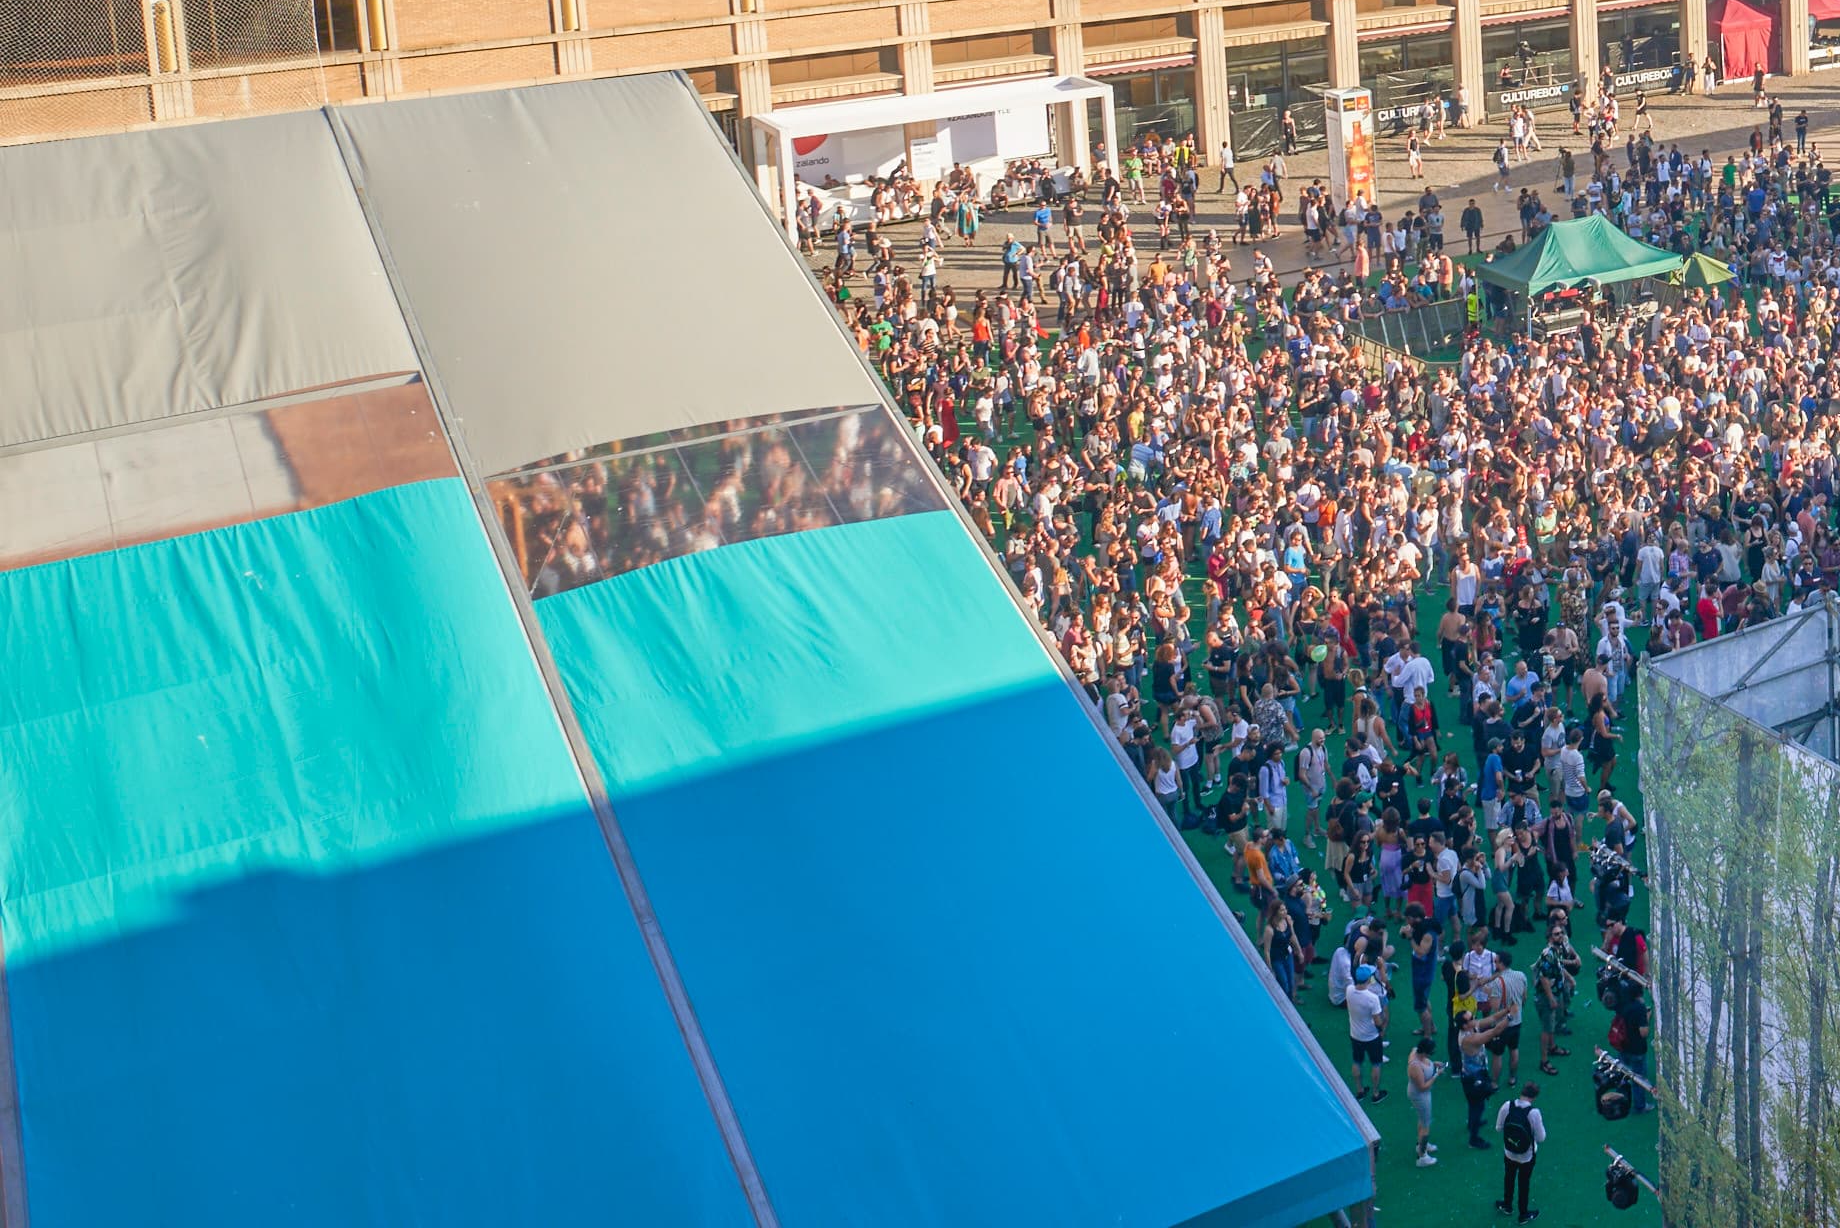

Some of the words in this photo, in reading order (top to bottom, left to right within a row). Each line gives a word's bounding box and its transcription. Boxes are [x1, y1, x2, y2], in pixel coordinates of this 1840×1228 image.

[1615, 69, 1673, 87] CULTUREBOX
[1501, 86, 1562, 103] CULTUREBOX
[1378, 106, 1421, 121] CULTUR
[796, 156, 830, 168] zalando
